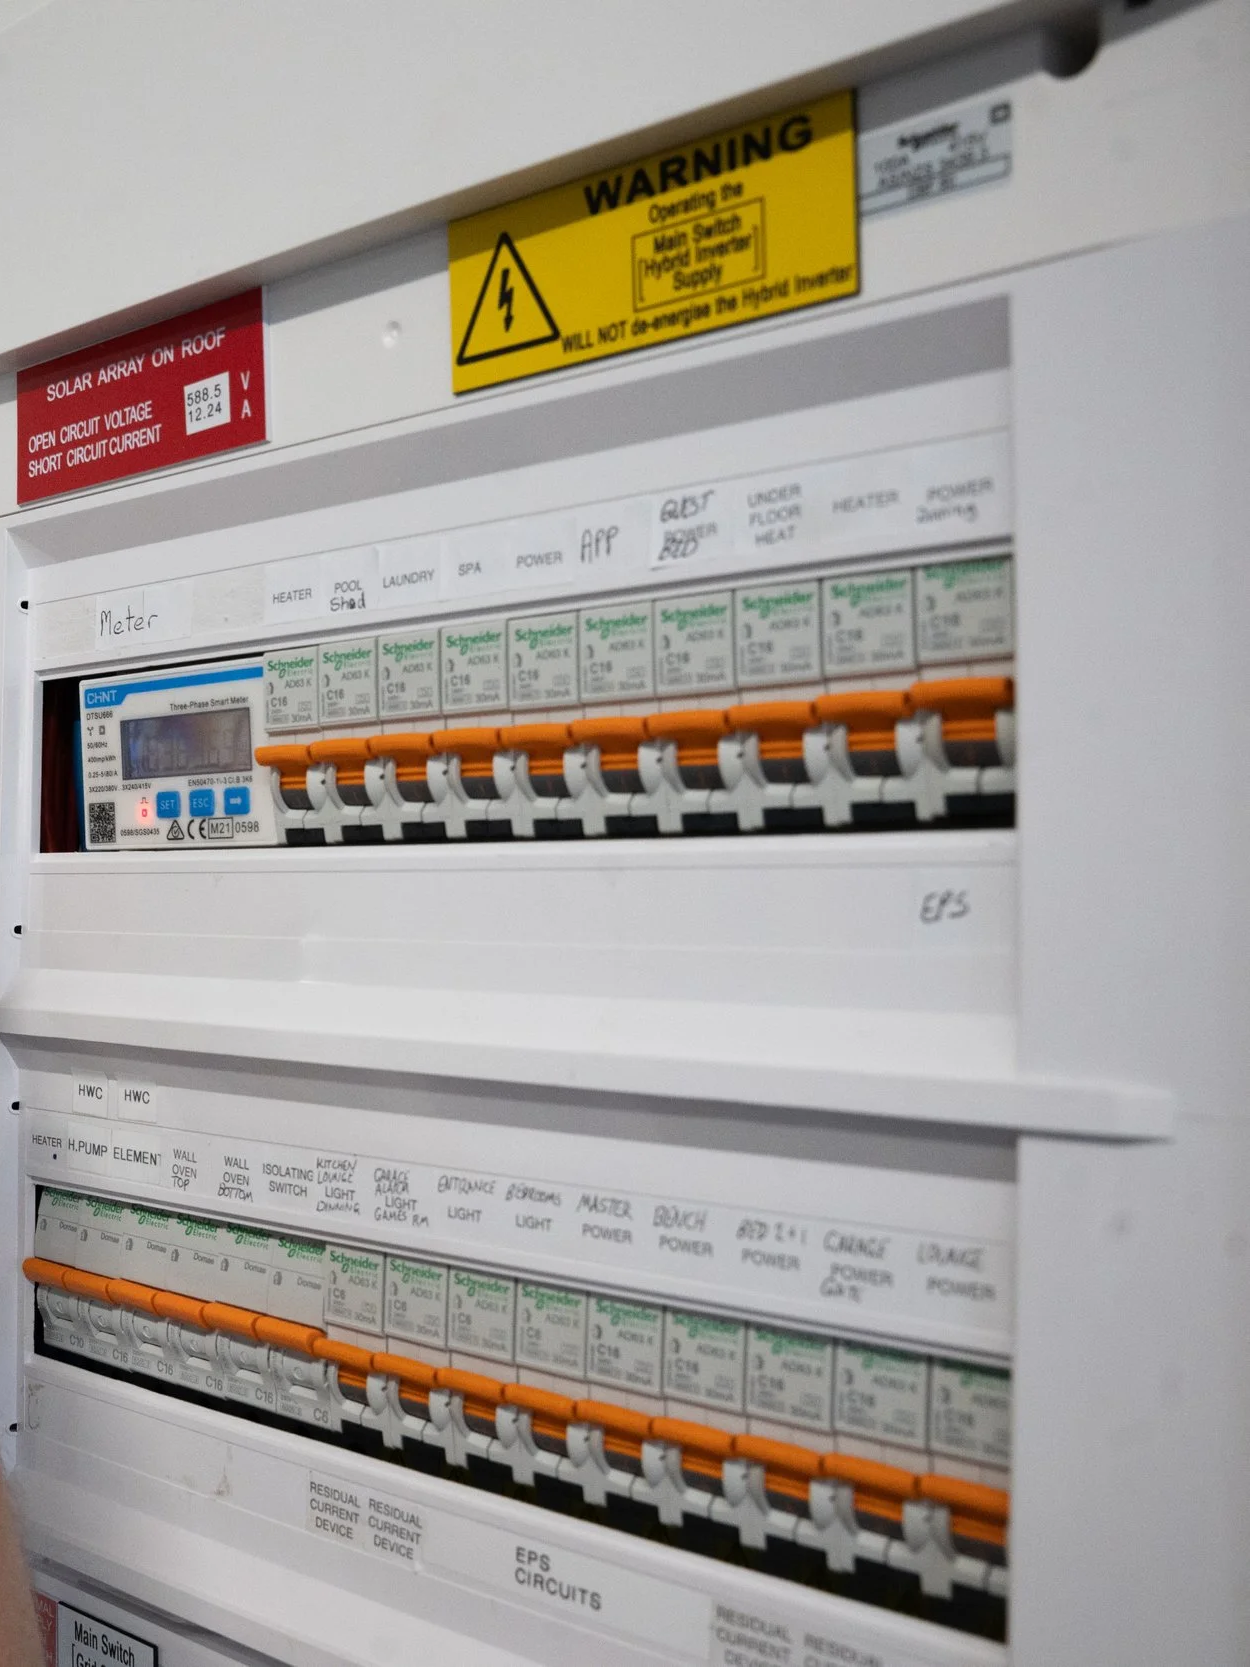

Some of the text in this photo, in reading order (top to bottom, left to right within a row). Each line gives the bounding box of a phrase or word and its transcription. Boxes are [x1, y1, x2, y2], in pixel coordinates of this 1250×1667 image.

[583, 114, 814, 215] WARNING
[648, 180, 744, 224] Operating the
[653, 214, 742, 254] Main Switch
[642, 233, 753, 281] Hybrid Inverter
[672, 263, 723, 291] Supply
[561, 263, 852, 353] WILL NOT de-energise the Hybrid Inverter
[46, 327, 227, 402] SOLAR ARRAY ON ROOF
[239, 371, 251, 391] V
[186, 384, 223, 409] 588.5
[187, 402, 223, 424] 12.24
[239, 399, 252, 420] A
[28, 400, 153, 454] OPEN CIRCUIT VOLTAGE
[28, 424, 163, 478] SHORT CIRCUIT CURRENT
[746, 482, 803, 509] UNDER
[926, 476, 995, 502] POWER
[831, 488, 899, 514] HEATER
[748, 503, 803, 528] FLOOR
[754, 523, 798, 550] HEAT
[458, 561, 482, 577] SPA
[515, 550, 563, 569] POWER
[334, 579, 363, 594] POOL
[382, 568, 435, 589] LAUNDRY
[272, 588, 313, 605] HEATER
[99, 605, 159, 637] Meter
[322, 649, 372, 671] Schneider
[382, 640, 435, 663] Schneider
[267, 656, 315, 678] Schneider
[326, 689, 345, 700] C16
[386, 682, 406, 695] C16
[169, 696, 249, 712] Three-Phase Smart Meter
[270, 696, 288, 708] C16
[160, 799, 175, 811] SET
[192, 797, 209, 809] ESC
[210, 822, 230, 835] M21
[234, 820, 260, 834] 0598
[78, 1083, 103, 1100] HWC
[123, 1088, 150, 1105] HWC
[32, 1133, 63, 1149] HEATER
[67, 1137, 108, 1159] H.PUMP
[172, 1148, 198, 1164] WALL
[223, 1155, 250, 1171] WALL
[316, 1156, 358, 1173] KITCHEN
[171, 1164, 198, 1180] OVEN
[222, 1171, 250, 1187] OVEN
[262, 1162, 314, 1182] ISOLATING
[170, 1175, 190, 1192] TOP
[268, 1180, 308, 1198] SWITCH
[325, 1185, 356, 1201] LIGHT
[217, 1185, 254, 1203] BOTTOM
[385, 1195, 418, 1212] LIGHT
[57, 1199, 79, 1211] Electric
[374, 1206, 408, 1221] GAMES
[447, 1205, 482, 1223] LIGHT
[99, 1210, 122, 1222] Electric
[145, 1218, 169, 1230] Electric
[176, 1213, 220, 1236] Schneider
[515, 1213, 552, 1233] LIGHT
[192, 1230, 218, 1242] Electric
[243, 1237, 269, 1250] Electric
[581, 1223, 633, 1245] POWER
[277, 1236, 326, 1258] Schneider
[658, 1234, 715, 1257] POWER
[329, 1250, 380, 1273] Schneider
[741, 1247, 801, 1272] POWER
[389, 1258, 443, 1284] Schneider
[830, 1262, 895, 1289] POWER
[332, 1287, 347, 1300] C6
[453, 1272, 511, 1297] Schneider
[925, 1275, 997, 1302] POWER
[393, 1299, 407, 1312] C6
[69, 1334, 85, 1349] C10
[112, 1348, 129, 1363] C16
[156, 1360, 174, 1376] C16
[205, 1375, 223, 1391] C16
[254, 1387, 274, 1405] C16
[313, 1407, 329, 1424] C6
[309, 1481, 361, 1509] RESIDUAL
[309, 1499, 360, 1525] CURRENT
[368, 1497, 424, 1529] RESIDUAL
[315, 1516, 354, 1540] DEVICE
[368, 1516, 422, 1545] CURRENT
[373, 1534, 414, 1561] DEVICE
[515, 1546, 551, 1573] EPS
[514, 1568, 603, 1612] CIRCUITS
[74, 1620, 99, 1651] Main
[101, 1634, 136, 1667] Switch
